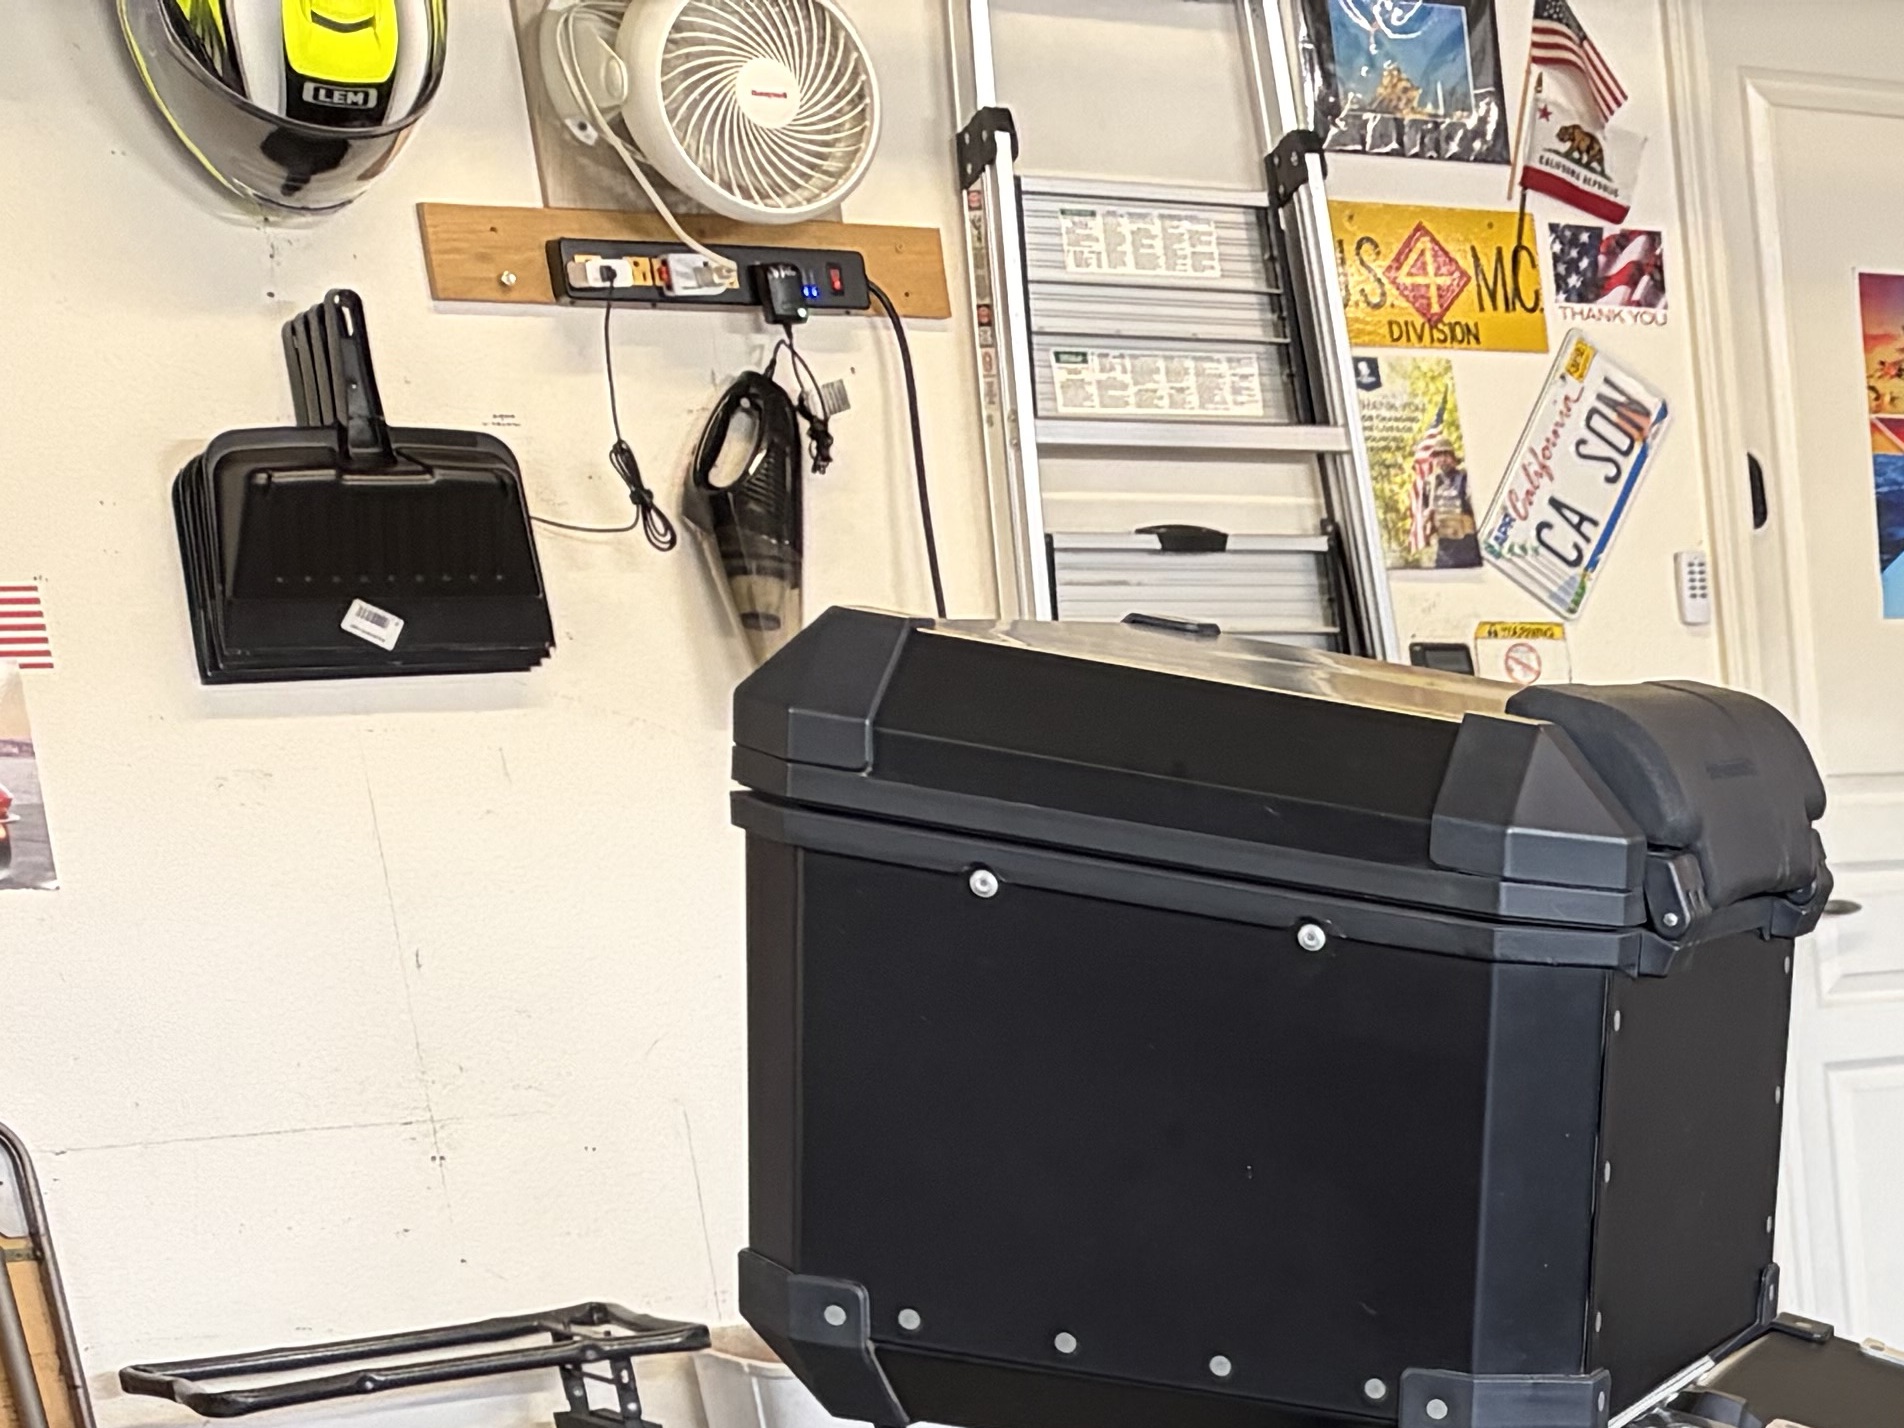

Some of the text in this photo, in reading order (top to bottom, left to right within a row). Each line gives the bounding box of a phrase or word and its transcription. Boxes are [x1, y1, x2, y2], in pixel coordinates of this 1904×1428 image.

[318, 87, 364, 106] LEM
[1558, 306, 1668, 327] THANK YOU
[1388, 319, 1481, 345] DIVISION
[1506, 386, 1585, 522] California
[1535, 496, 1600, 568] CA
